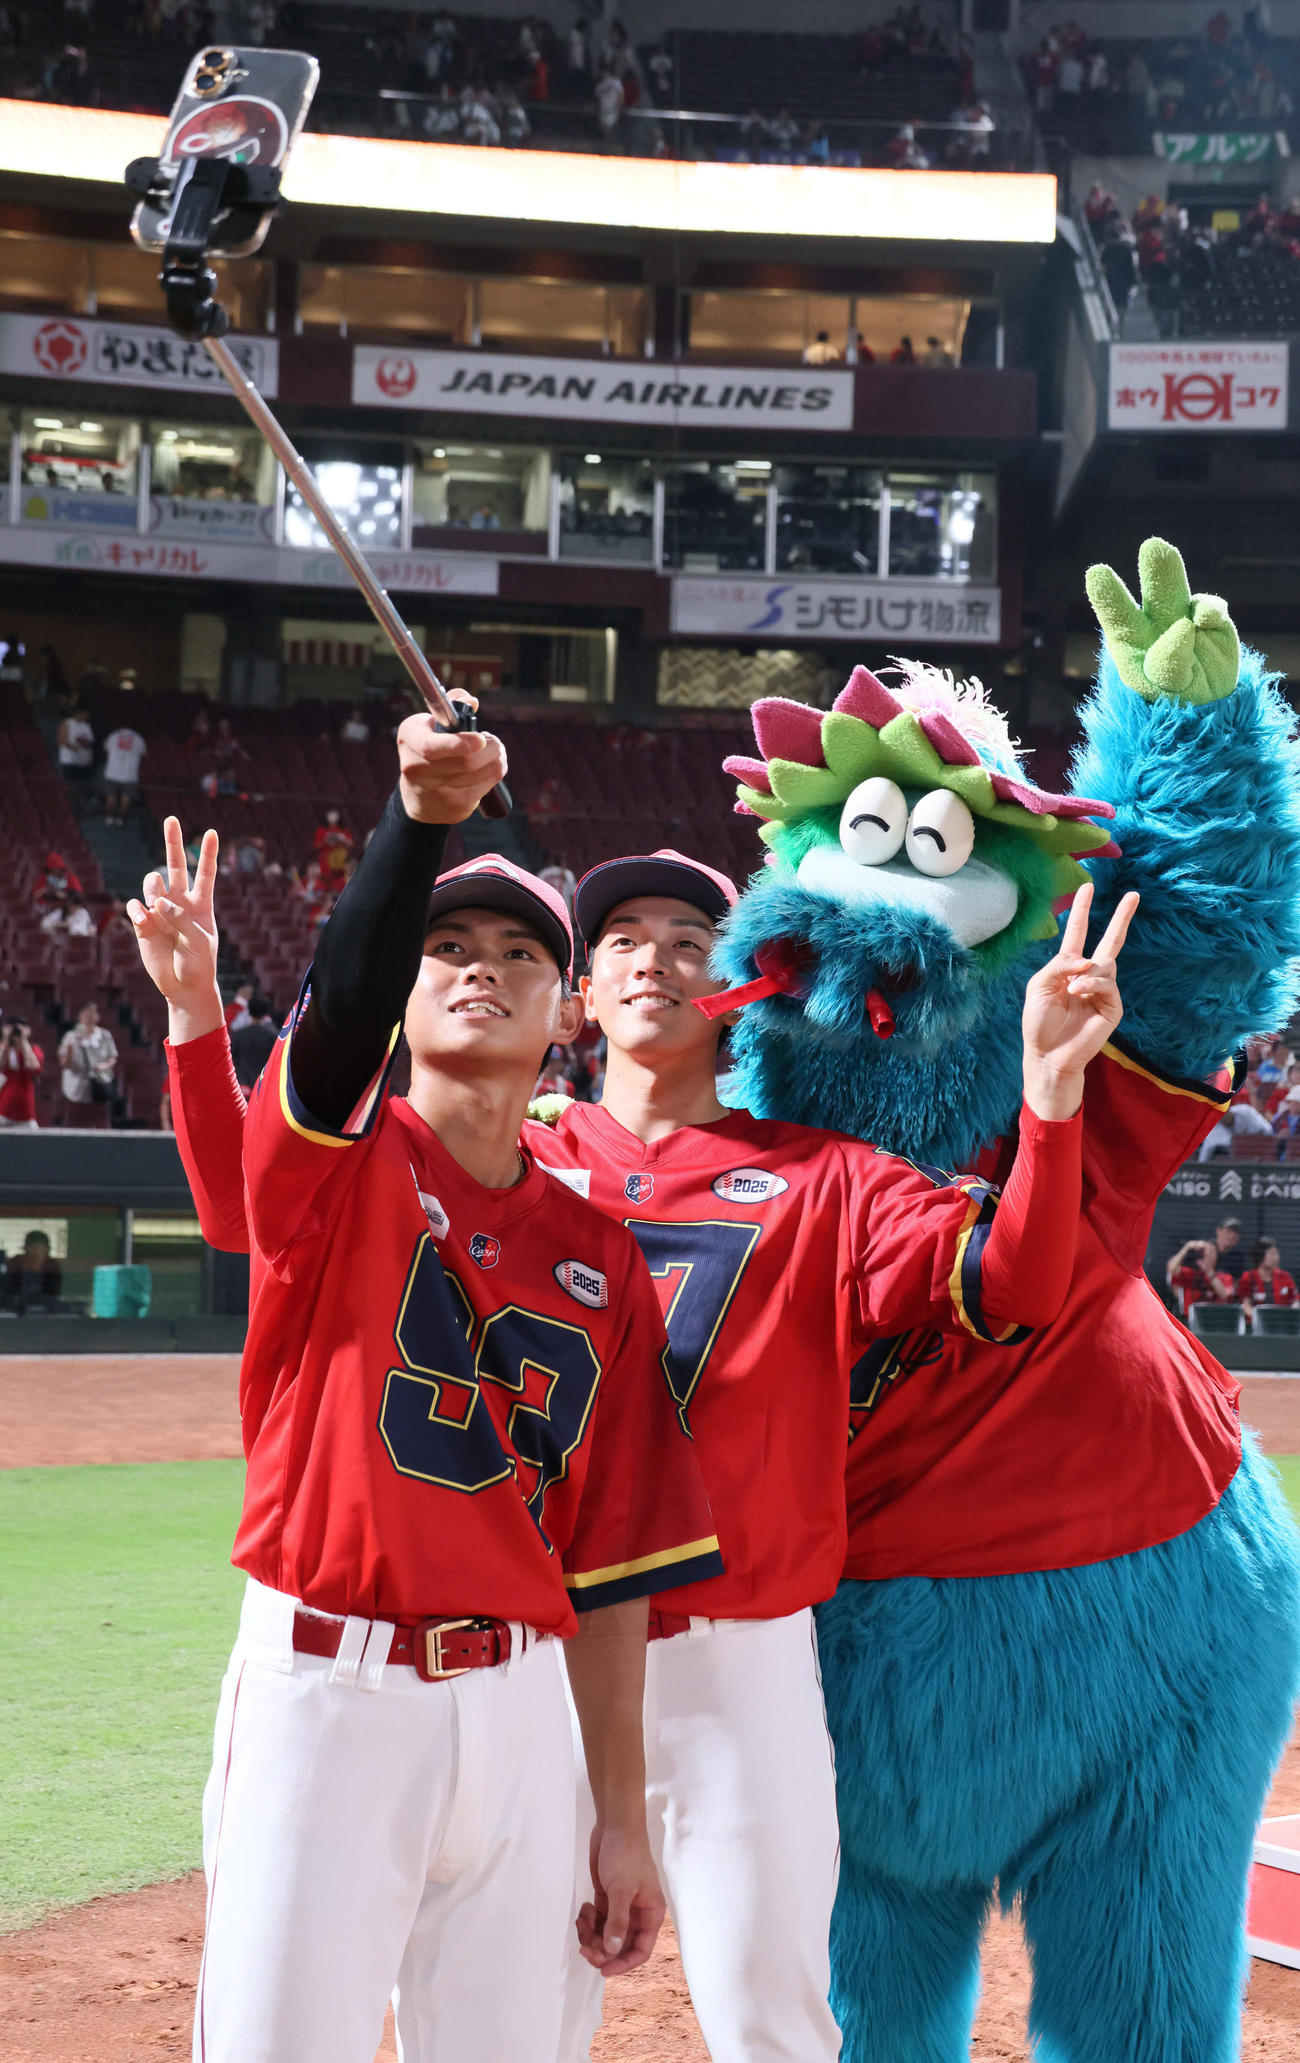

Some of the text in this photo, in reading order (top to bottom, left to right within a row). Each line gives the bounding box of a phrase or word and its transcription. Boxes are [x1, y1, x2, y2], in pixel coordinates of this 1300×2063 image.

[441, 368, 834, 412] JAPAN AIRLINES
[795, 592, 991, 636] シモハナ物流
[733, 1177, 769, 1193] 2025
[470, 1244, 496, 1258] Carp
[572, 1268, 601, 1297] 2025
